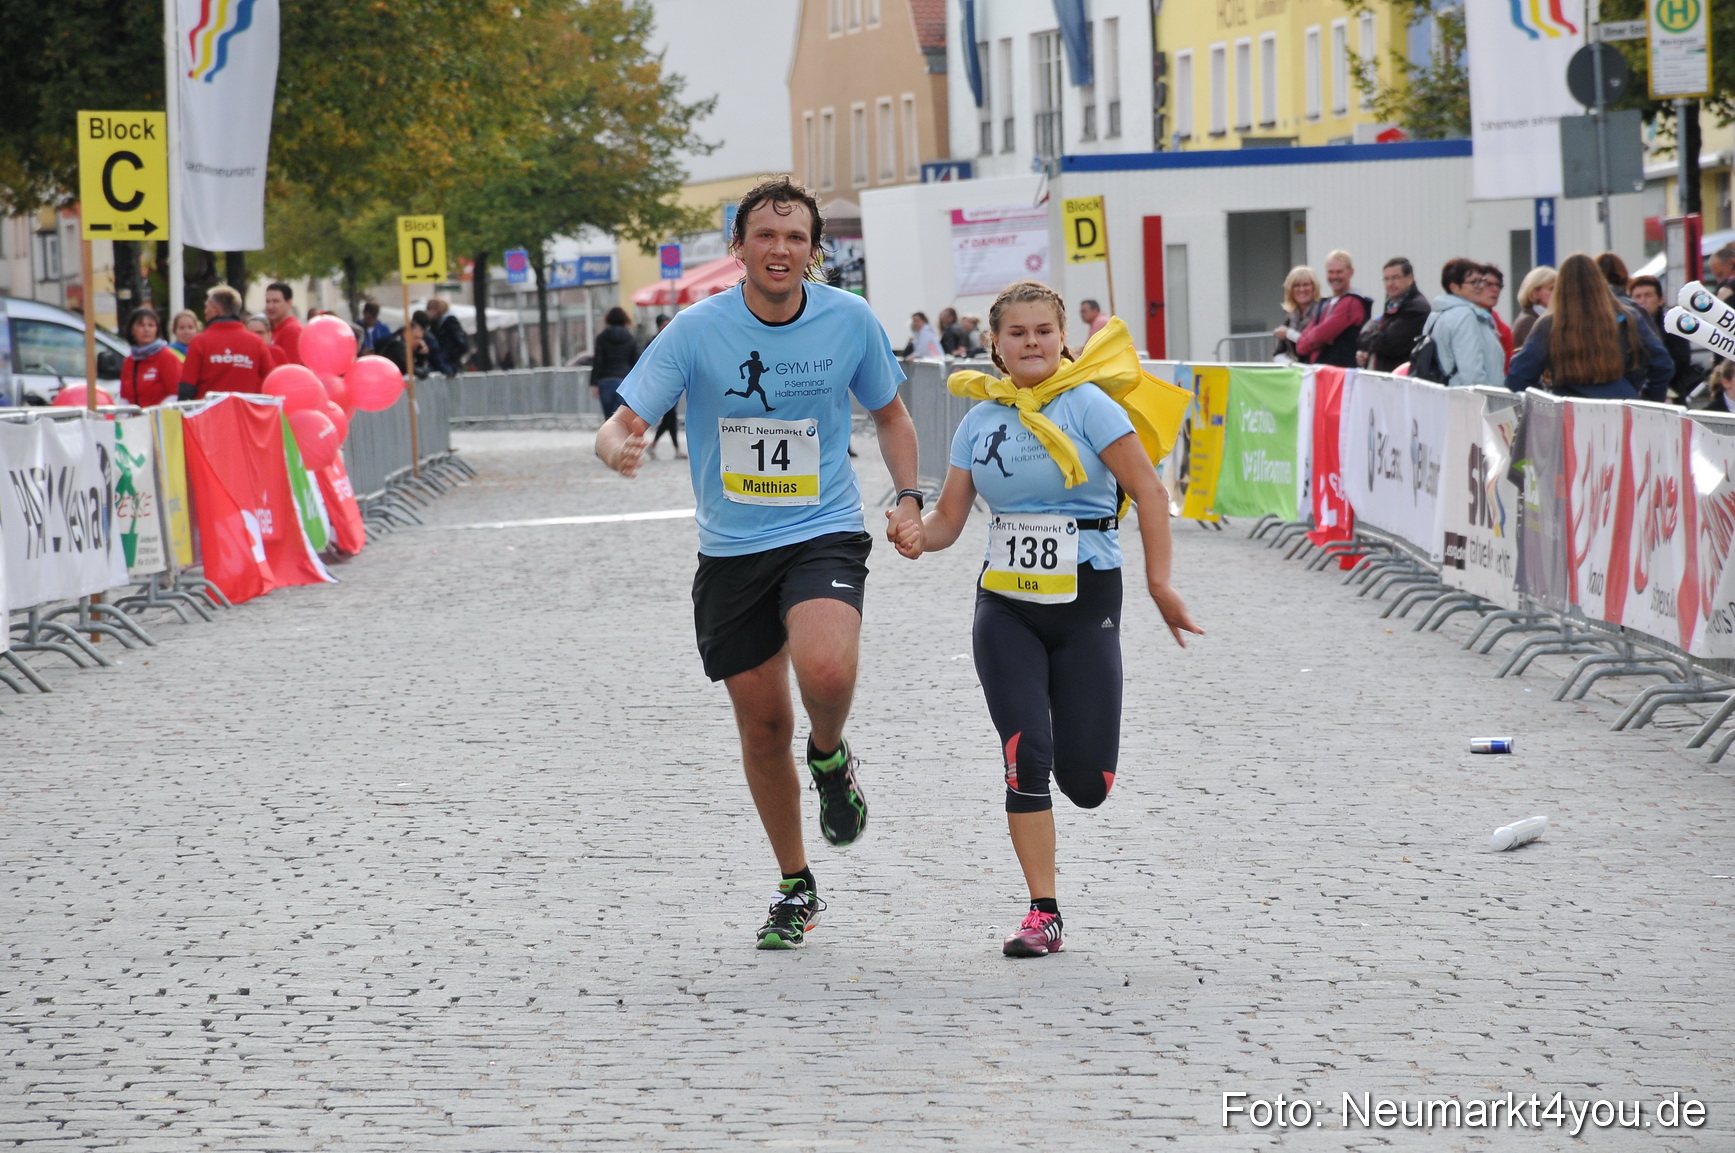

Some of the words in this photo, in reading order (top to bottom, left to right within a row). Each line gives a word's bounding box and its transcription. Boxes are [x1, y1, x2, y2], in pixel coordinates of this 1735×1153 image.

[90, 117, 156, 140] Block
[102, 150, 145, 212] C
[1066, 197, 1102, 214] Block
[403, 220, 439, 232] Block
[1074, 217, 1097, 249] D
[411, 237, 434, 268] D
[775, 362, 810, 376] GYM
[813, 358, 834, 373] HIP
[774, 386, 833, 398] Halbmarathon
[784, 379, 825, 388] P-Seminar
[721, 425, 754, 435] PARTL
[756, 427, 803, 437] Neumarkt
[751, 439, 791, 472] 14
[742, 478, 797, 494] Matthias
[1018, 523, 1062, 534] Neumarkt
[1006, 536, 1058, 570] 138
[1017, 577, 1039, 591] Lea
